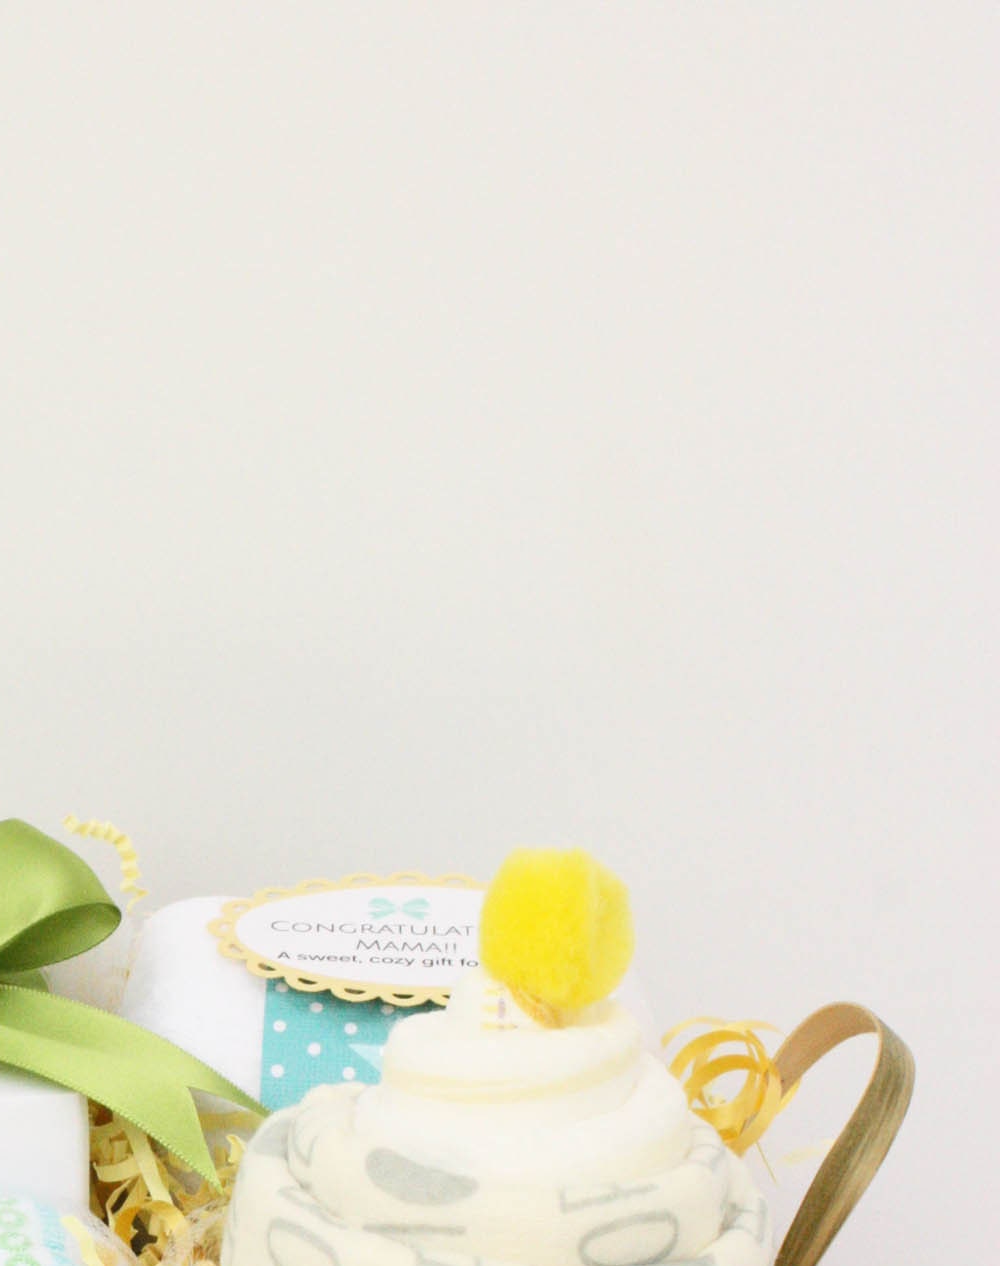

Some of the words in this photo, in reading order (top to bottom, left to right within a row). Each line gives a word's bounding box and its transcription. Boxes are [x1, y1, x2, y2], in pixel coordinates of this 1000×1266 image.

[271, 920, 474, 937] CONGRATULAT
[277, 951, 291, 960] A
[297, 954, 362, 964] sweet,
[369, 956, 416, 967] cozy
[422, 957, 455, 968] gift
[461, 958, 479, 968] fo
